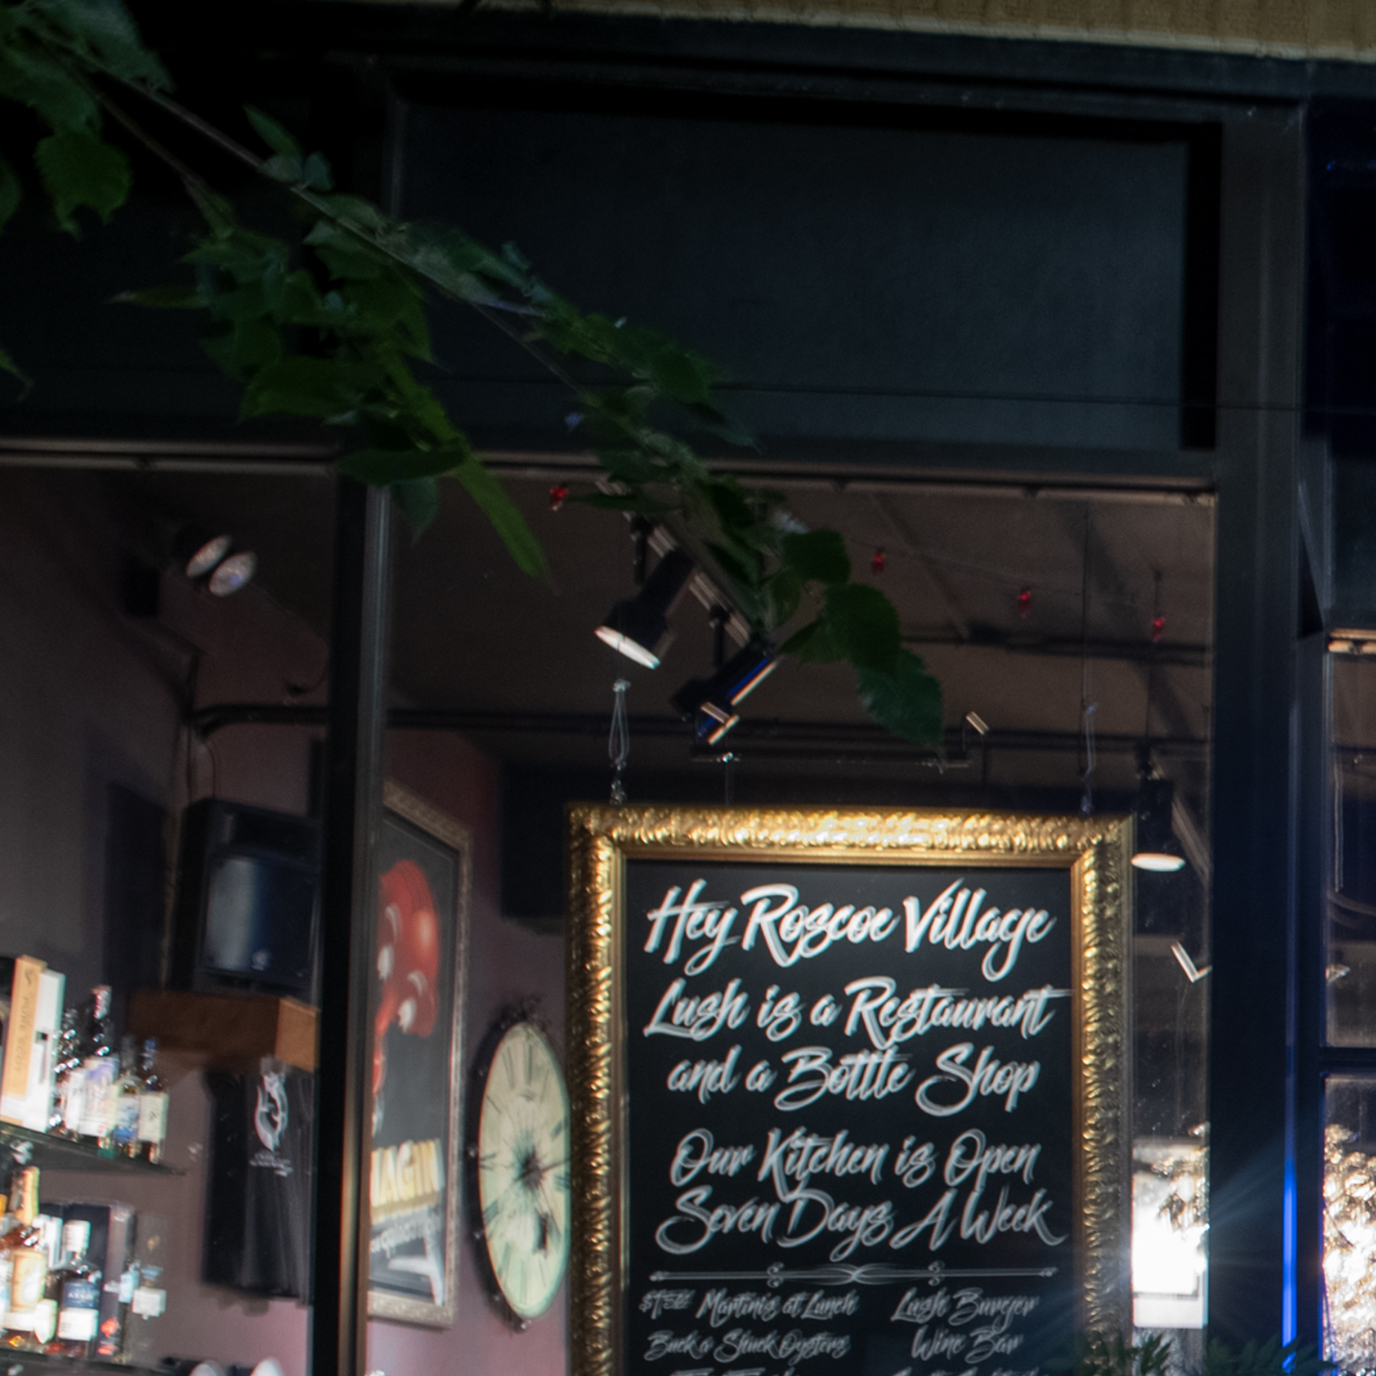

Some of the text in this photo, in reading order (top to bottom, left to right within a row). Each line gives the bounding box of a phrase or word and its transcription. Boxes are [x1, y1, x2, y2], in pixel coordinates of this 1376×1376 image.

[643, 877, 1057, 981] Hey Roscoe Village
[643, 975, 1074, 1050] Lush is a Restaurant
[667, 1042, 1041, 1117] and a Bottle Shop
[670, 1126, 1042, 1203] Our Kitchen is Open
[654, 1183, 1071, 1262] Seven Days A Week
[695, 1287, 782, 1329] Martinis
[782, 1293, 807, 1319] at
[800, 1289, 862, 1321] Lunch
[890, 1286, 1040, 1334] Lush Burger
[911, 1324, 1024, 1365] Wine Bar
[643, 1329, 704, 1361] Buck
[713, 1328, 781, 1363] Shuck
[778, 1329, 852, 1367] Oysters
